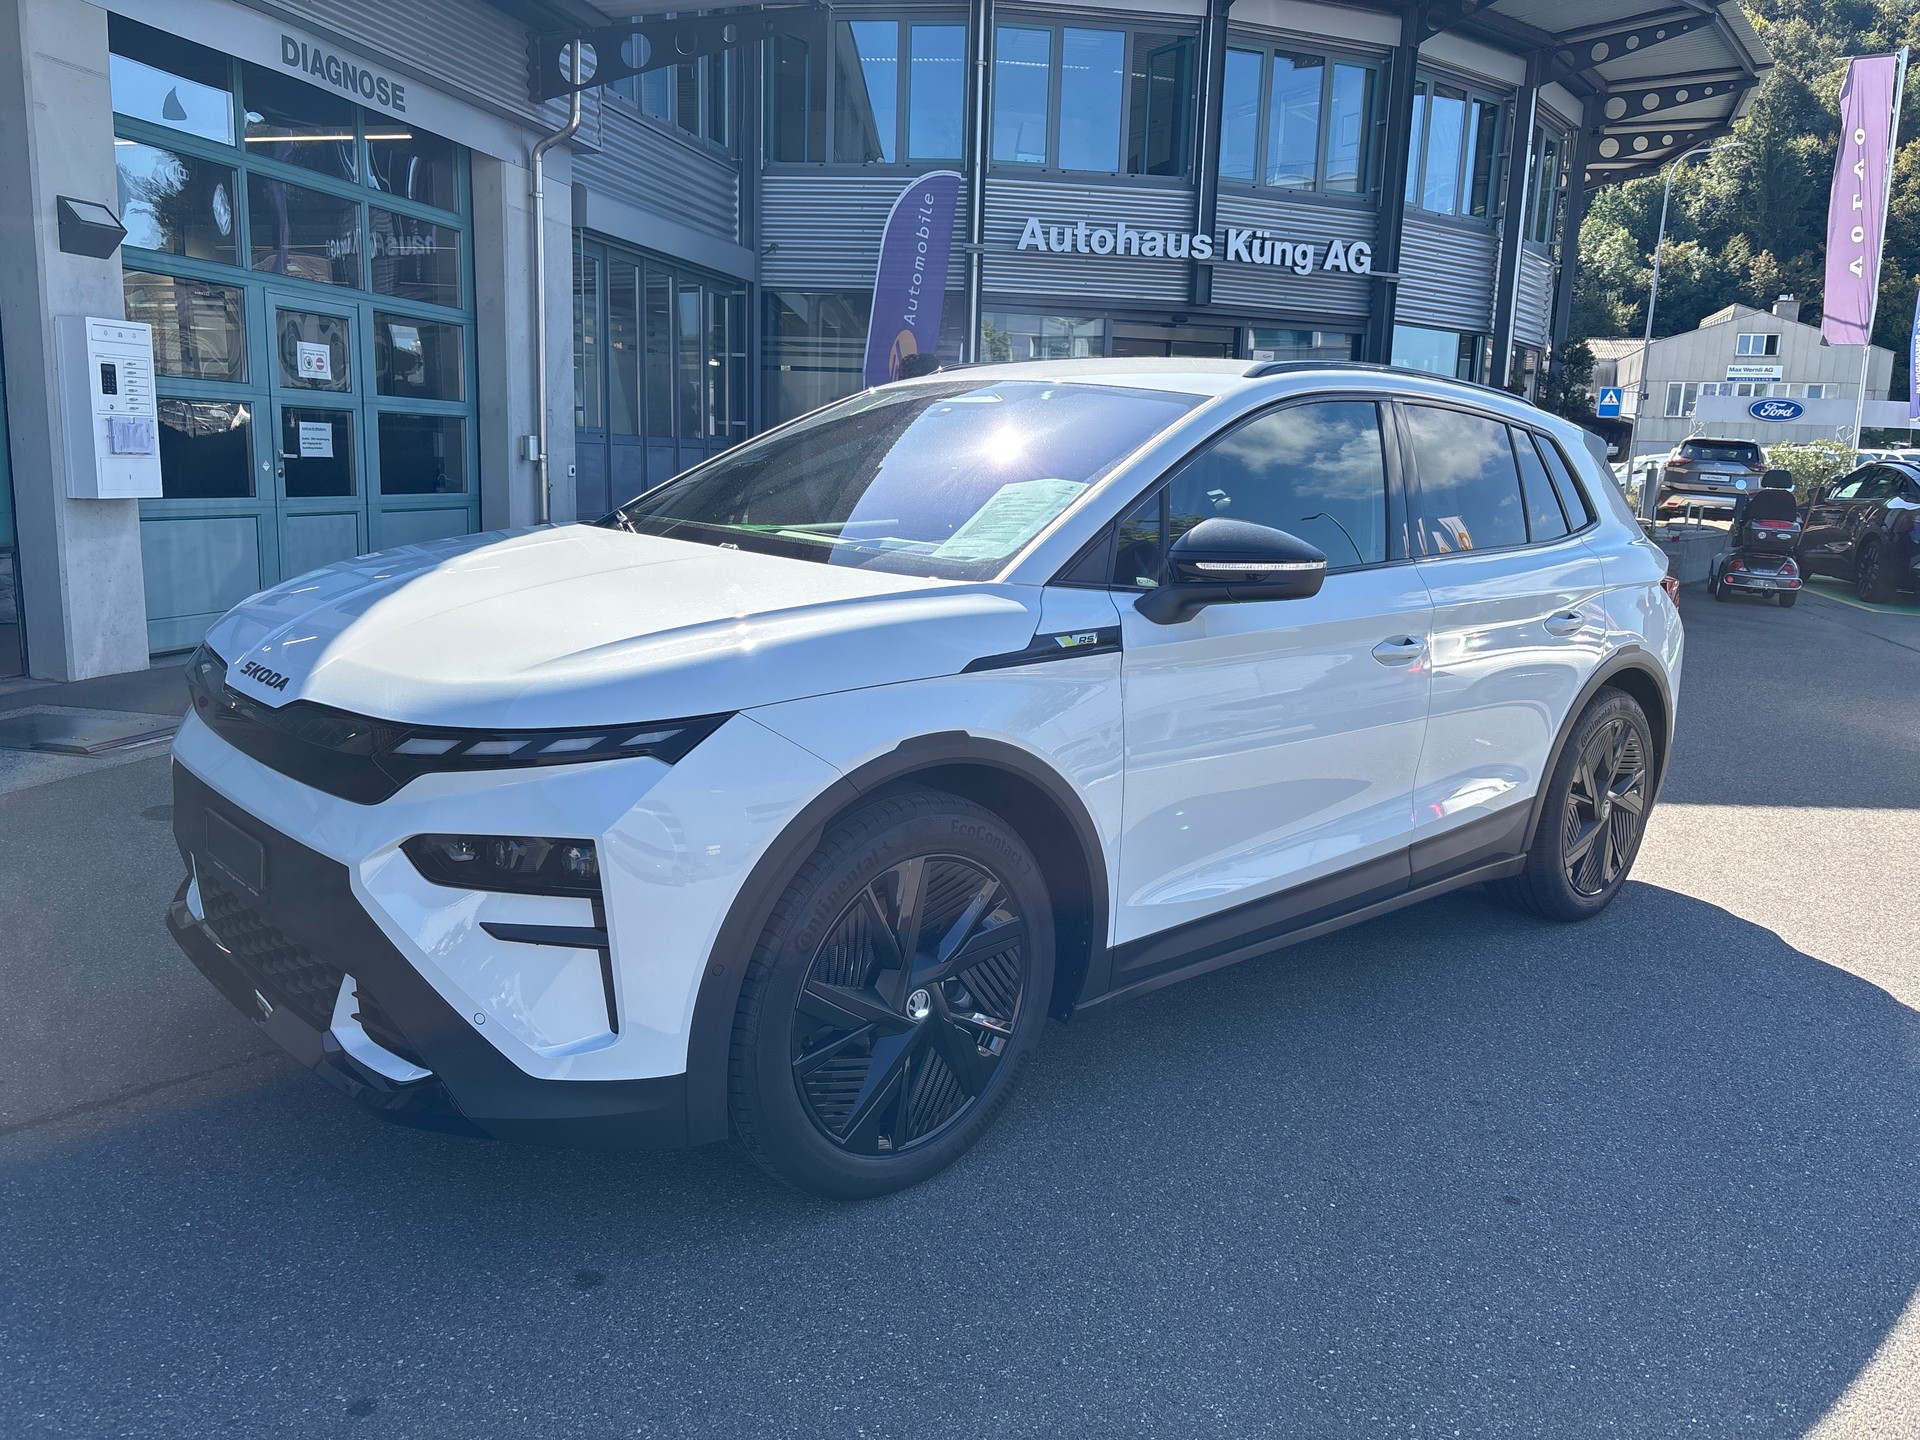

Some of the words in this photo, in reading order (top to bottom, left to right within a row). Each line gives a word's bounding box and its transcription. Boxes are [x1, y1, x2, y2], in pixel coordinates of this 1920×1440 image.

[281, 34, 406, 113] DIAGNOSE
[903, 192, 934, 326] Automobile
[1016, 216, 1213, 260] Autohaus
[1225, 228, 1315, 276] Küng
[1322, 239, 1372, 275] AG
[1760, 402, 1795, 417] Ford
[1581, 704, 1613, 748] Continental
[950, 819, 1024, 865] EcoContact
[794, 847, 880, 955] Continental
